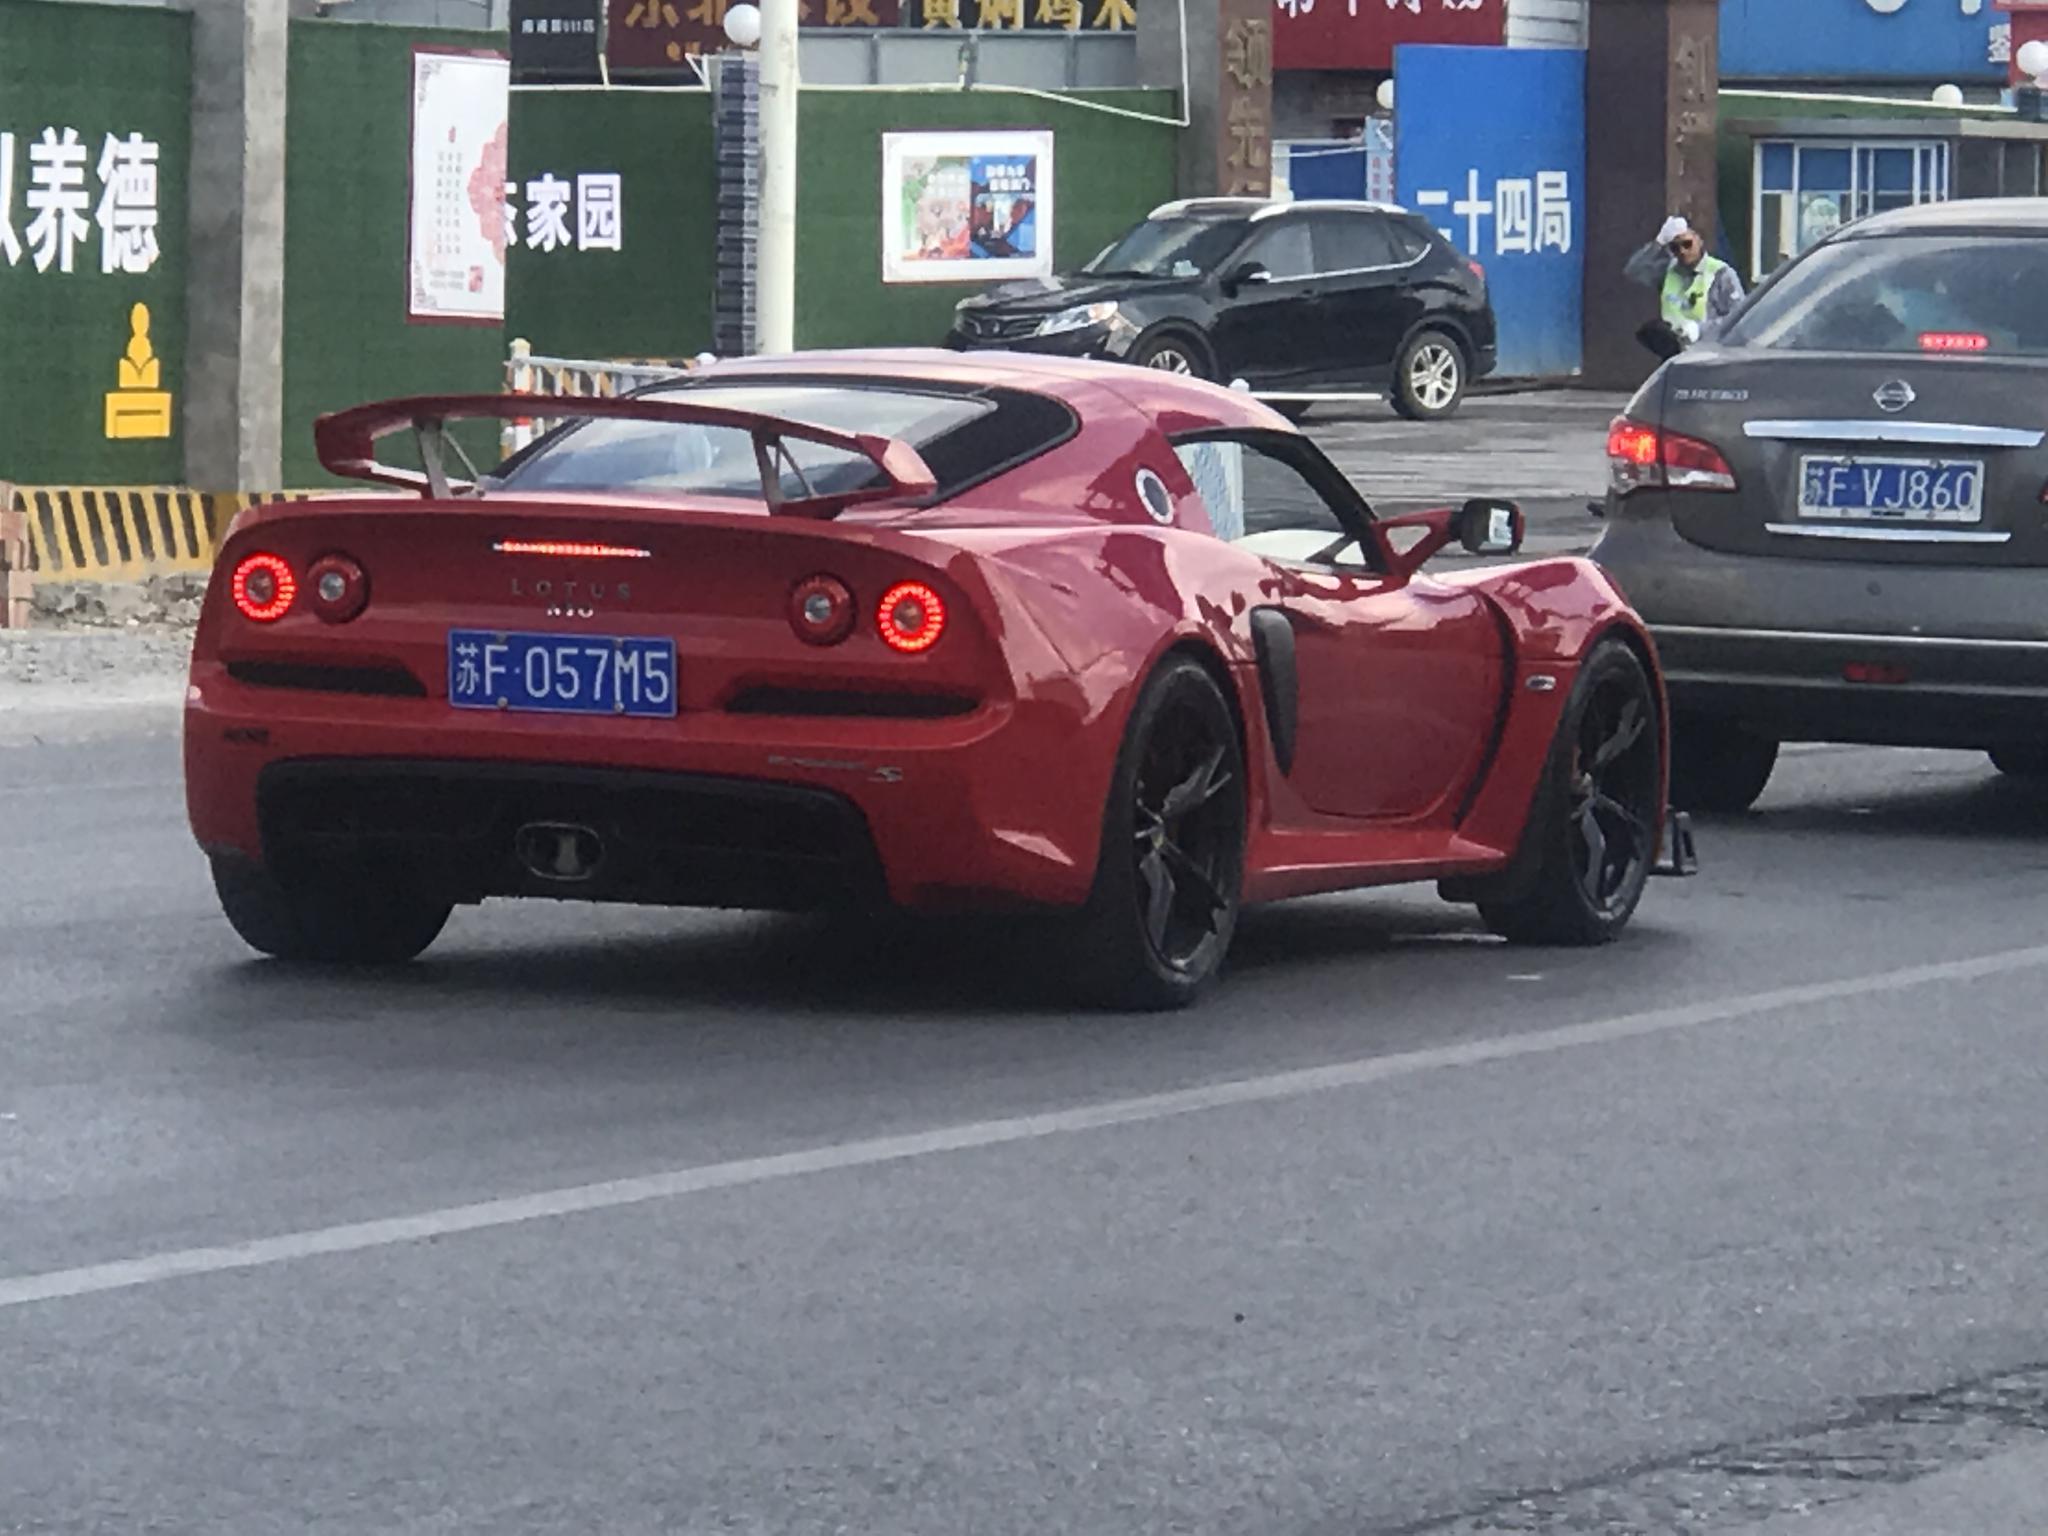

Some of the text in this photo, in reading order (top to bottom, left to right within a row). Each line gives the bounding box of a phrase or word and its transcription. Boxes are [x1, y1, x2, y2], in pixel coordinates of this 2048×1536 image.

[1416, 168, 1571, 256] 二十四局
[511, 578, 631, 600] LOTUS
[456, 642, 669, 704] 苏F·057M5
